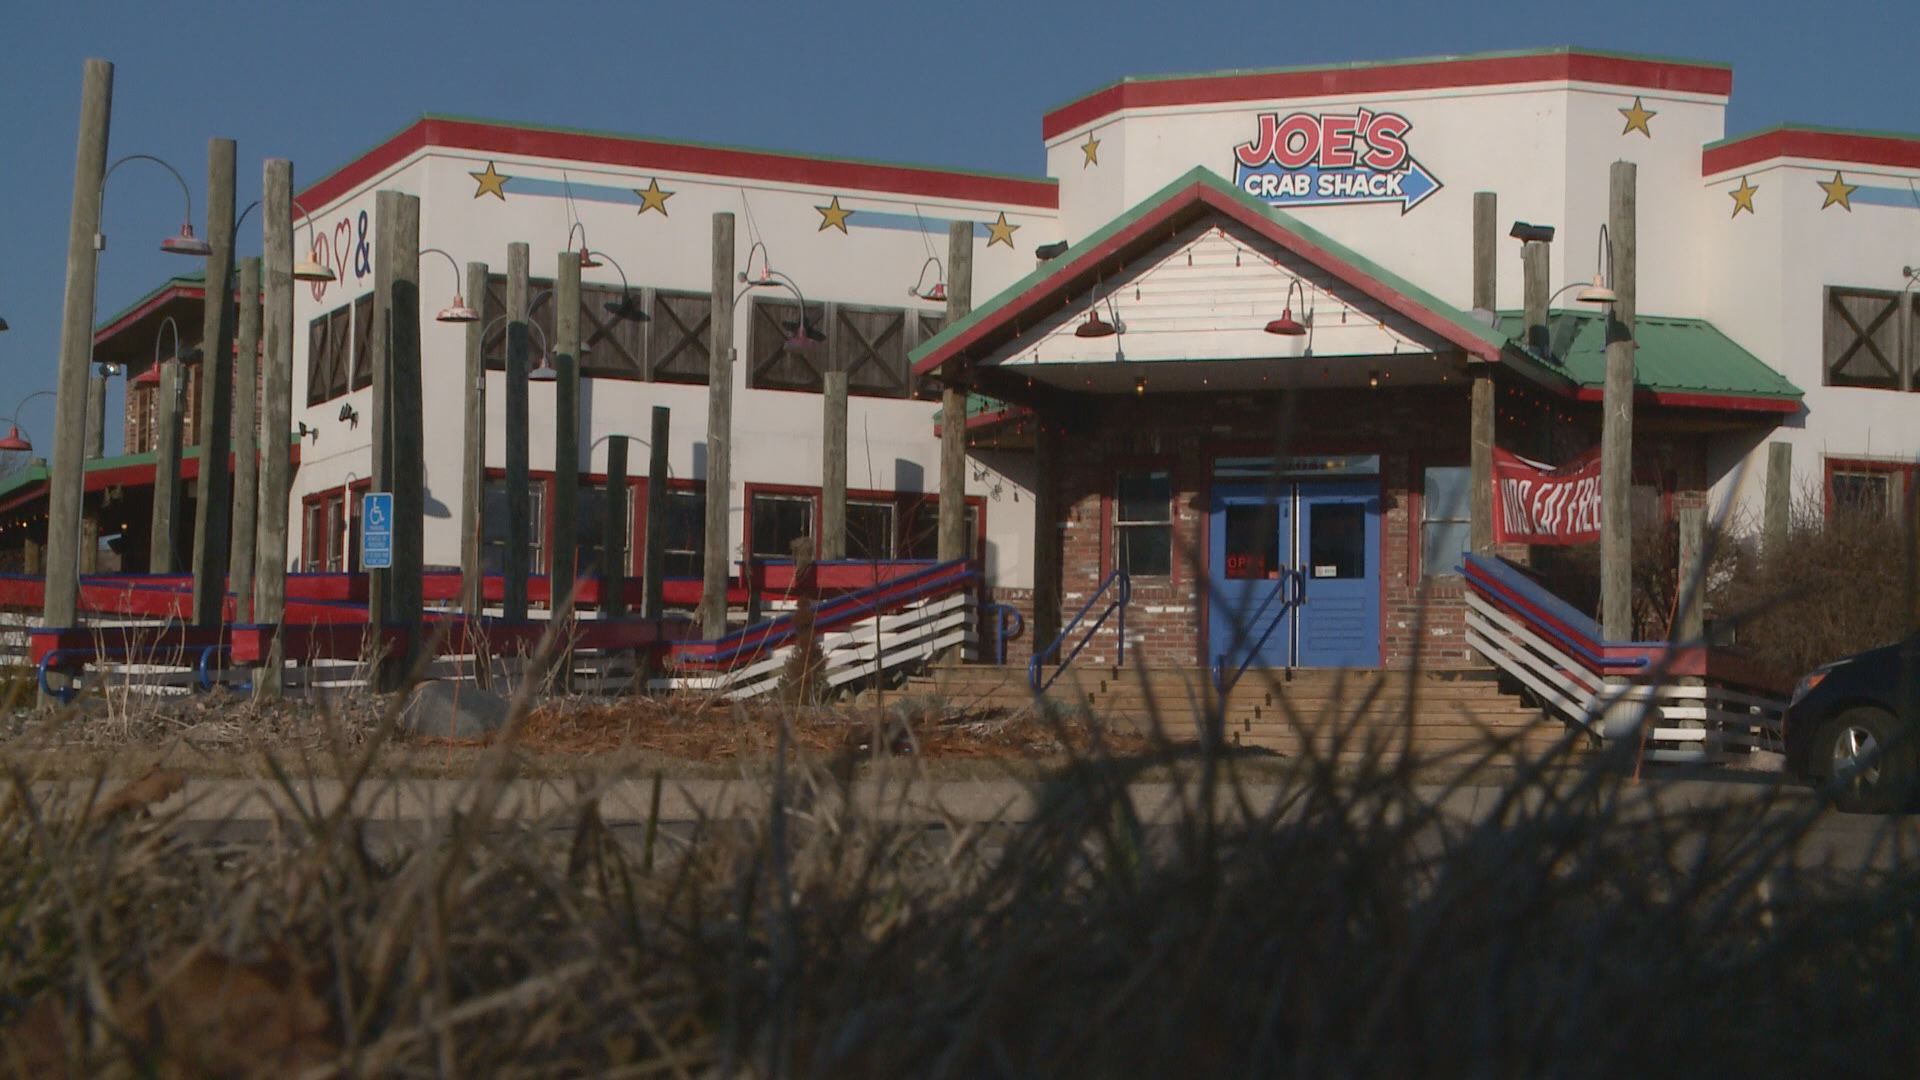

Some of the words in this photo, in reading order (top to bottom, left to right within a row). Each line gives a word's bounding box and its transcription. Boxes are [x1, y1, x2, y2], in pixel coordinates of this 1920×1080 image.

[1234, 107, 1412, 171] JOE'S
[1244, 173, 1312, 198] CRAB
[1317, 172, 1405, 198] SHACK
